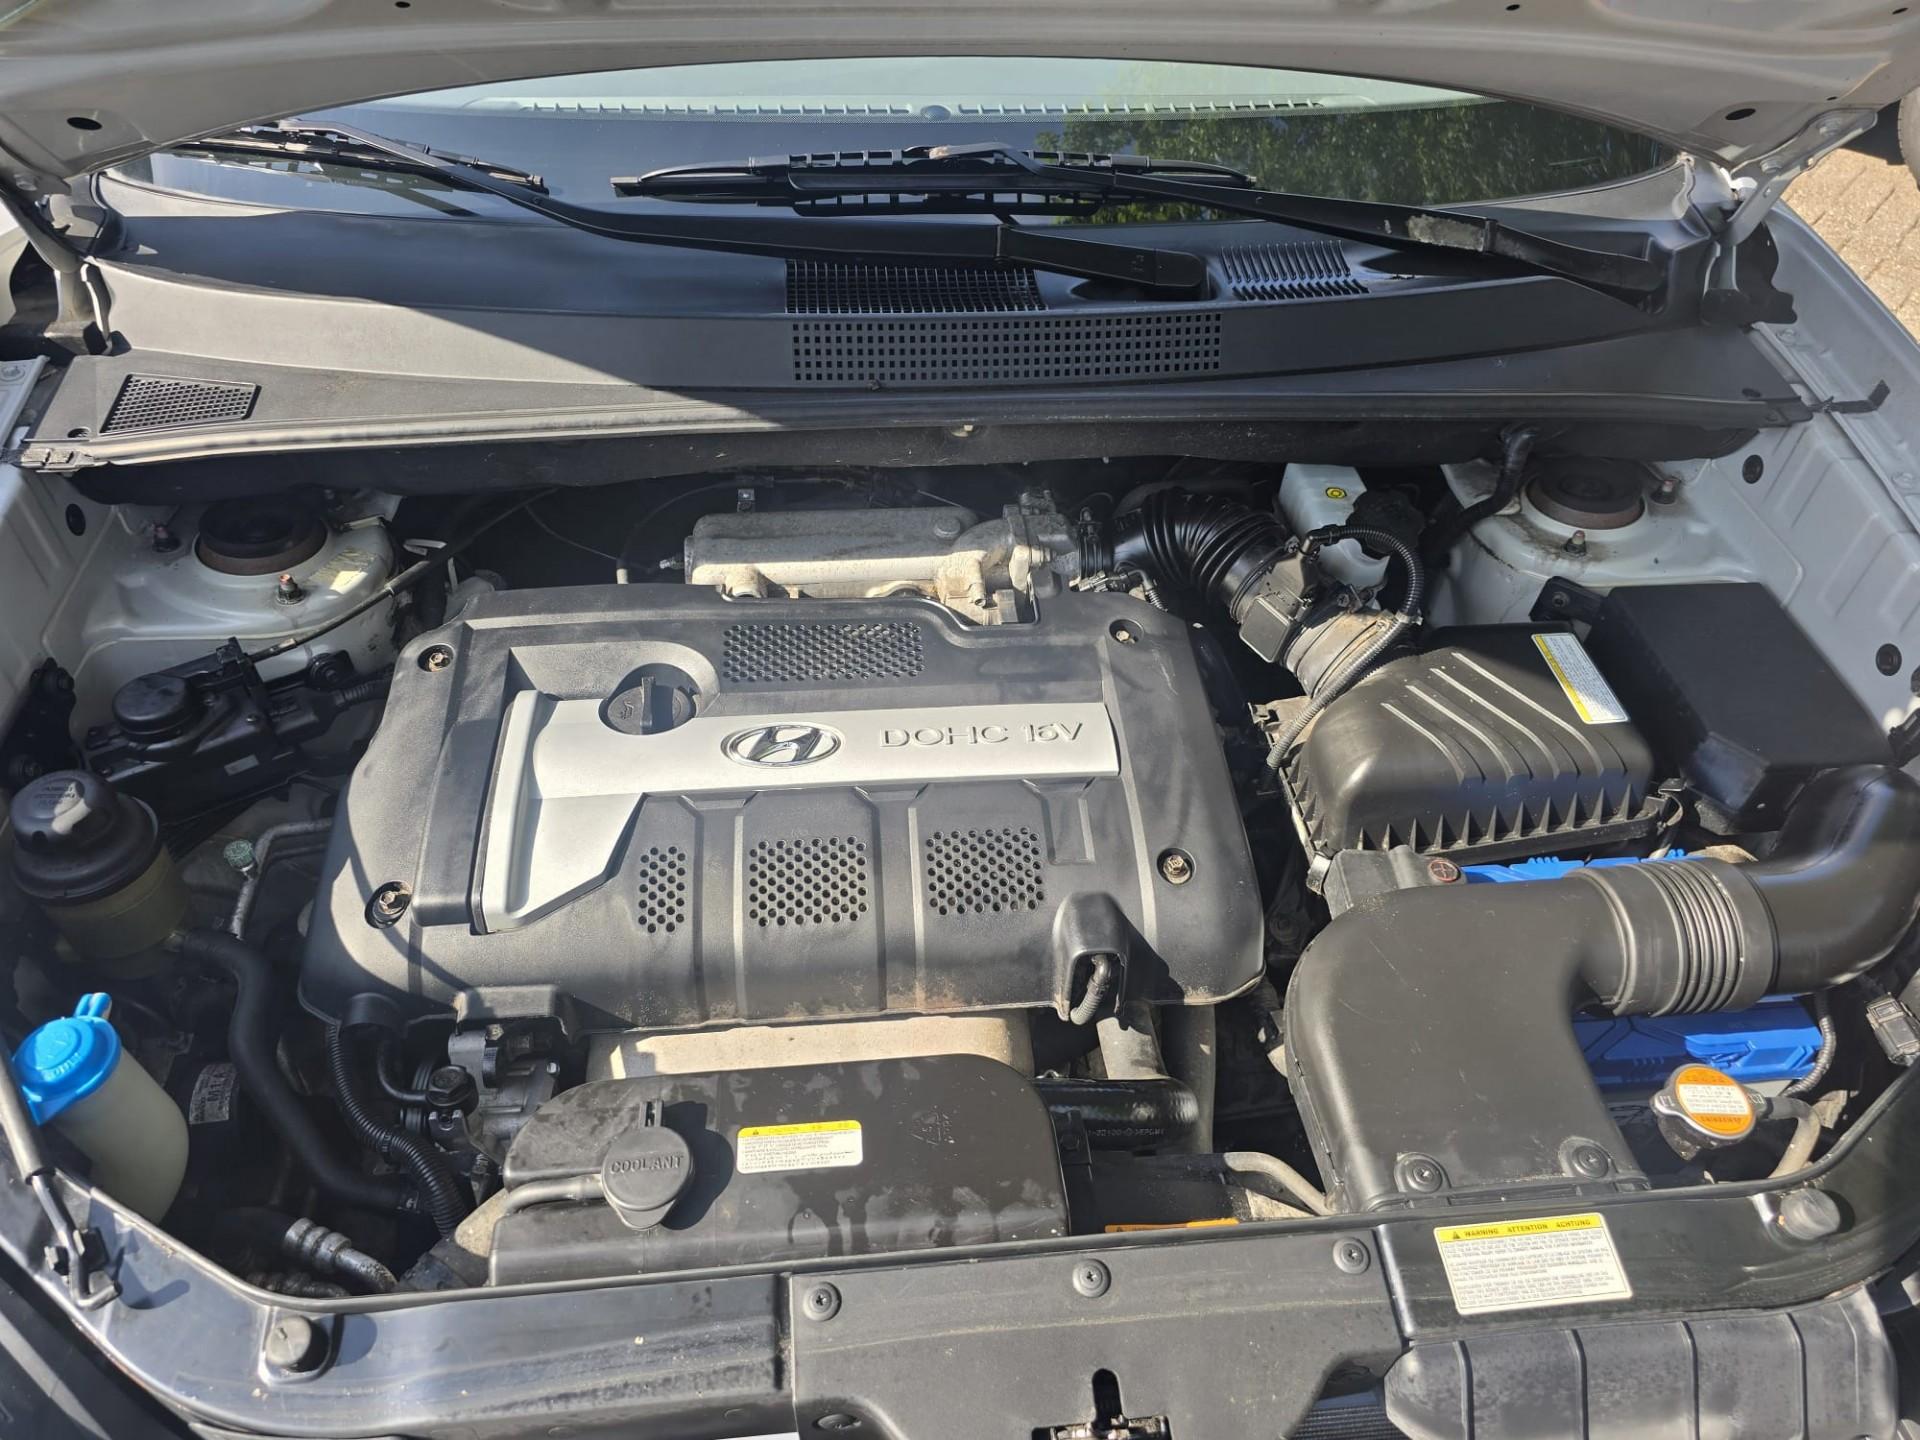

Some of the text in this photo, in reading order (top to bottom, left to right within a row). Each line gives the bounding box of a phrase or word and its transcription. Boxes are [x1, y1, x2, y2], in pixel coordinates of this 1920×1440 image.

[880, 722, 1083, 747] DOHC 16V
[610, 1154, 684, 1174] COOLANT
[1465, 1220, 1591, 1238] WARNING ATTENTION ACHTUNG
